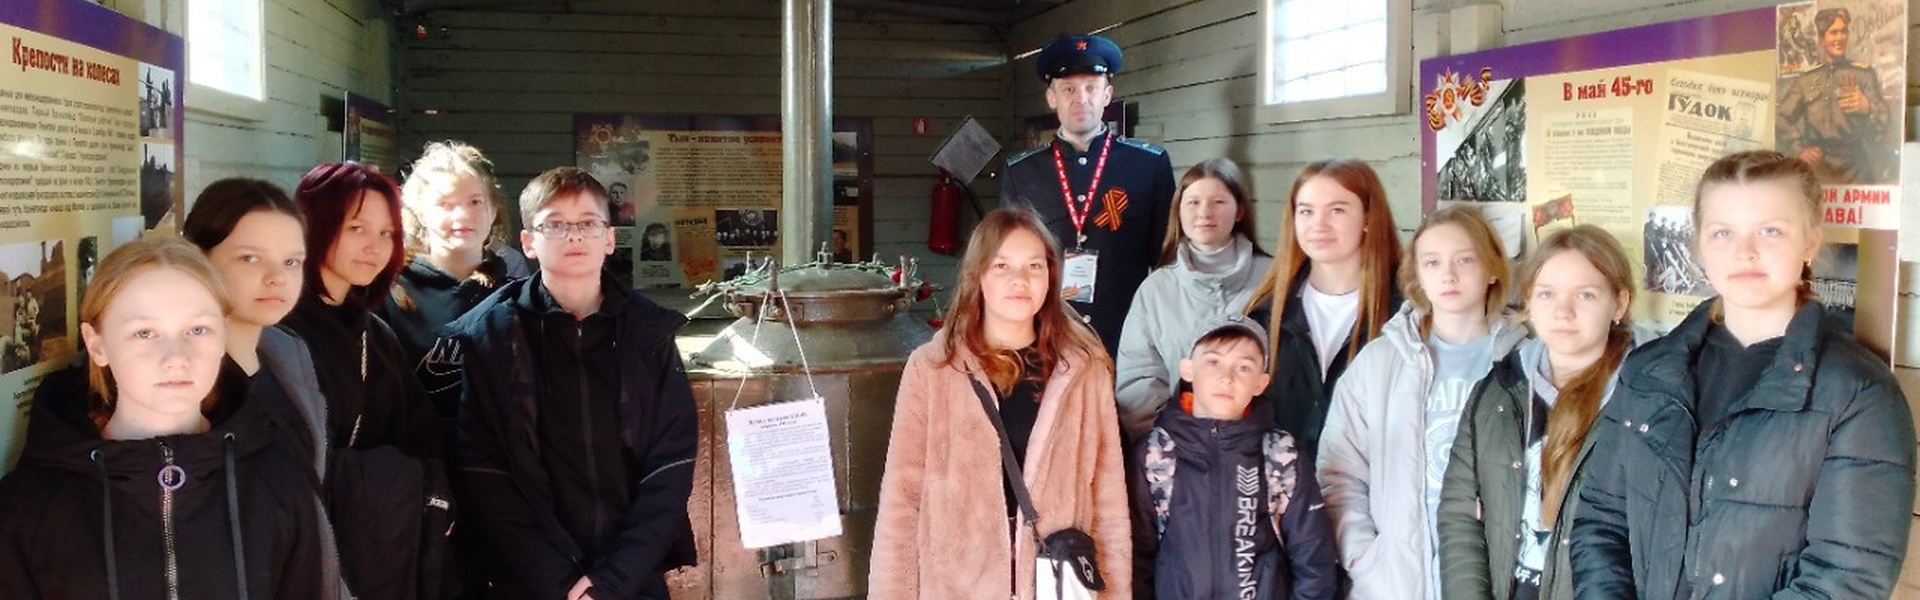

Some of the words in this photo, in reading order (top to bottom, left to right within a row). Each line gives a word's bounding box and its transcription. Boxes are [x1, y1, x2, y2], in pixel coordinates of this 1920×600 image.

[12, 37, 69, 75] Крепости
[72, 57, 84, 77] на
[86, 61, 120, 86] колесах
[1564, 82, 1573, 101] В
[1578, 79, 1606, 100] май
[1611, 76, 1653, 97] 45-го
[1668, 93, 1732, 121] ГУДОК
[1843, 189, 1891, 204] АРМИИ
[1235, 497, 1258, 600] BREAKING
